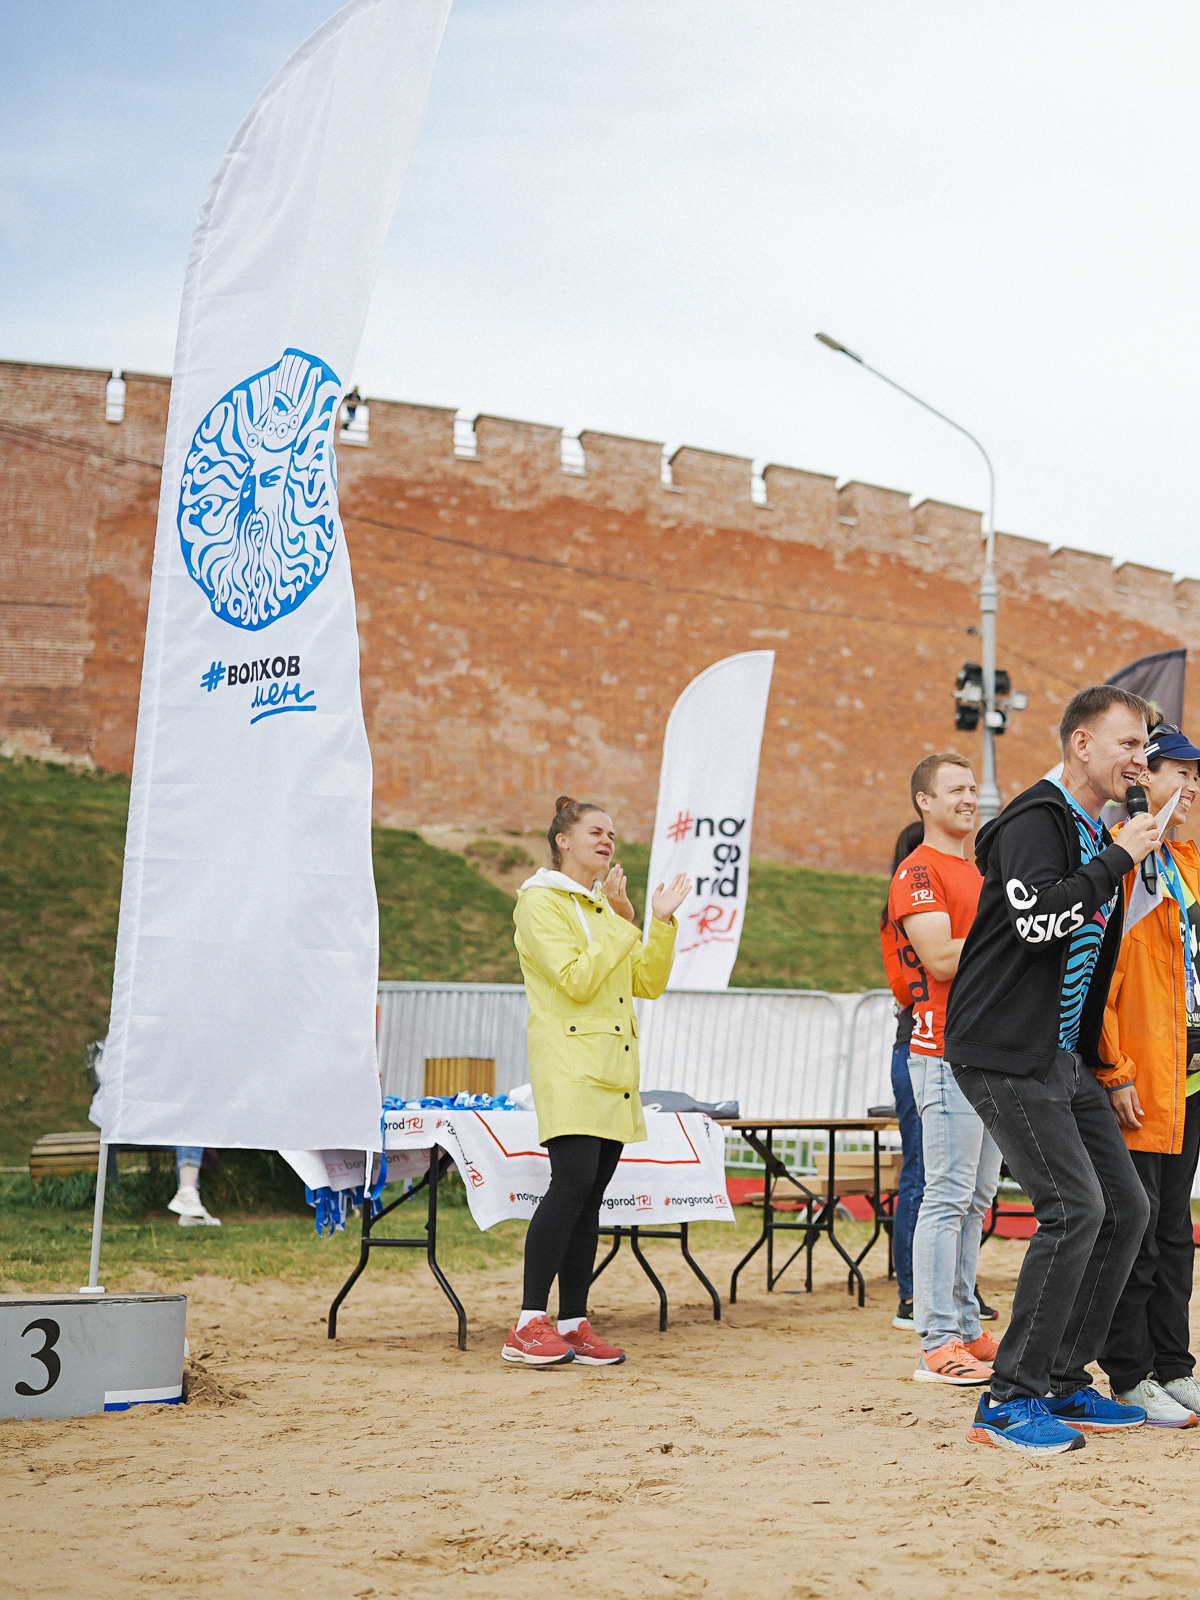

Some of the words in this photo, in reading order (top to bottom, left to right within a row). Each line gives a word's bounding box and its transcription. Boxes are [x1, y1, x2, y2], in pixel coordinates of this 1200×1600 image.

[200, 655, 300, 692] #ВОЛХОВ
[910, 877, 931, 890] rod
[913, 872, 929, 882] go
[911, 889, 934, 902] TRI
[15, 1318, 61, 1396] 3
